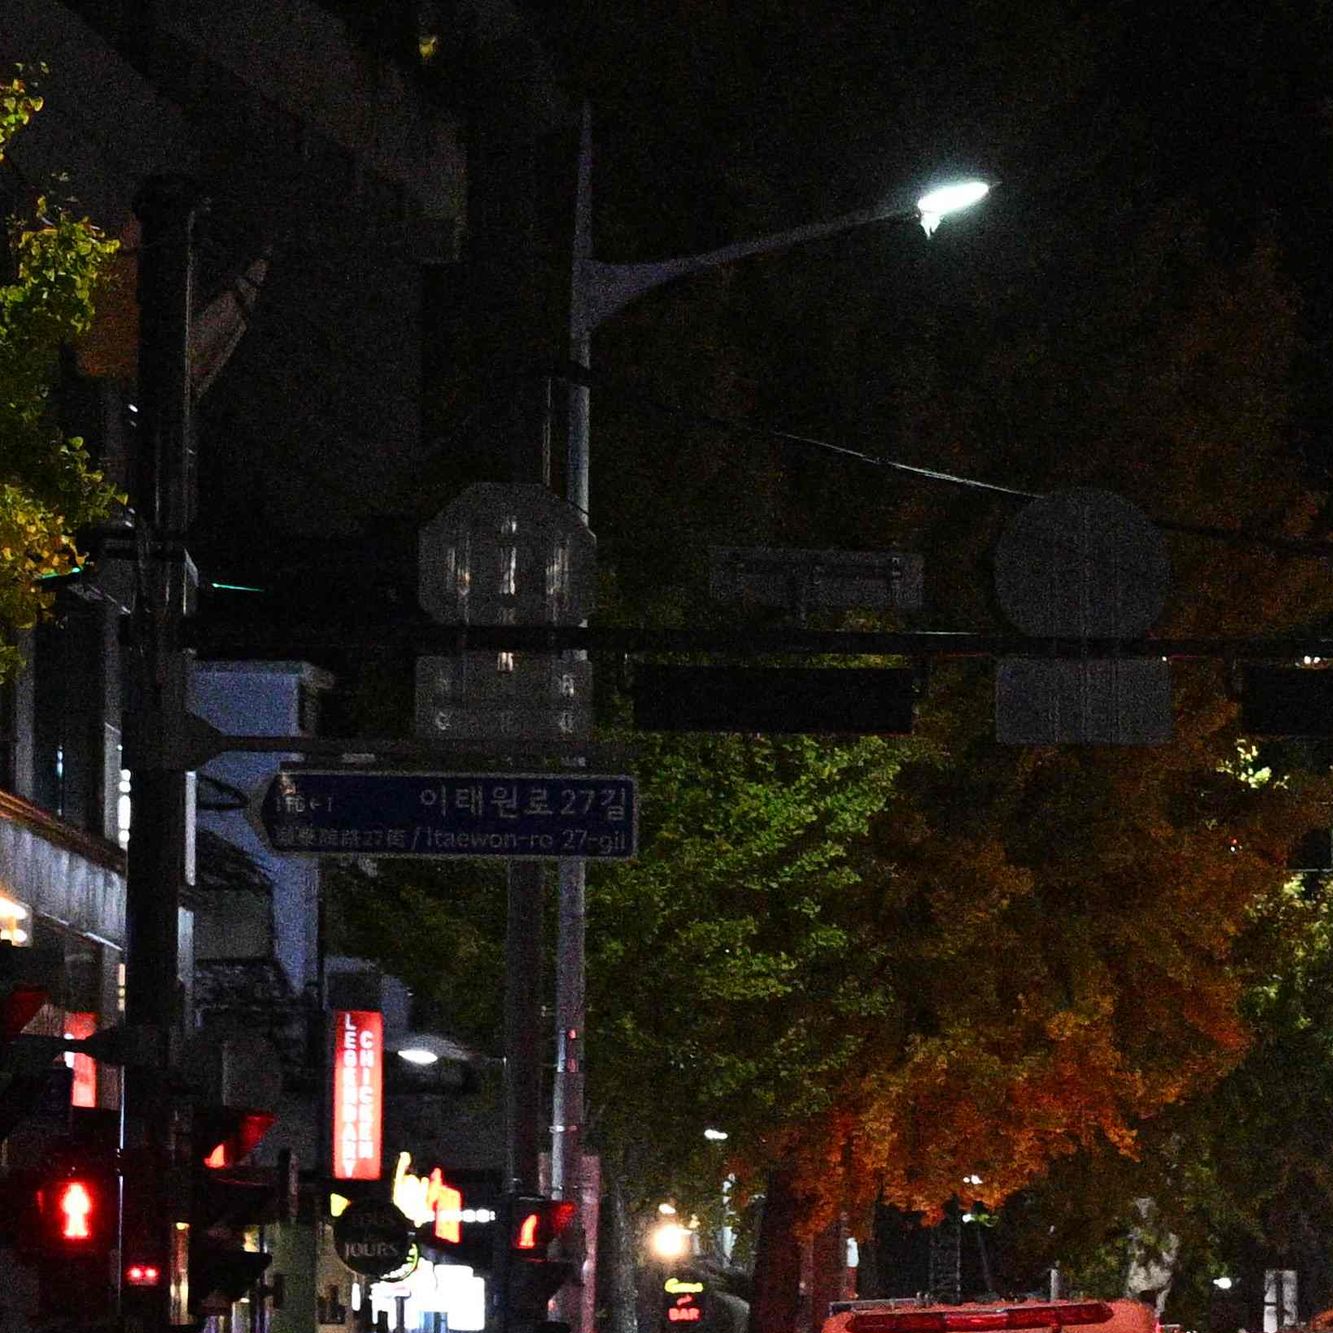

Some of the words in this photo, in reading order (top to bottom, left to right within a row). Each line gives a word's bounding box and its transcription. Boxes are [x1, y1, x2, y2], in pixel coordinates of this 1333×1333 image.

[417, 783, 627, 822] 이태원로27길
[426, 827, 553, 849] Itaewon-ro
[562, 829, 626, 854] 27-gil
